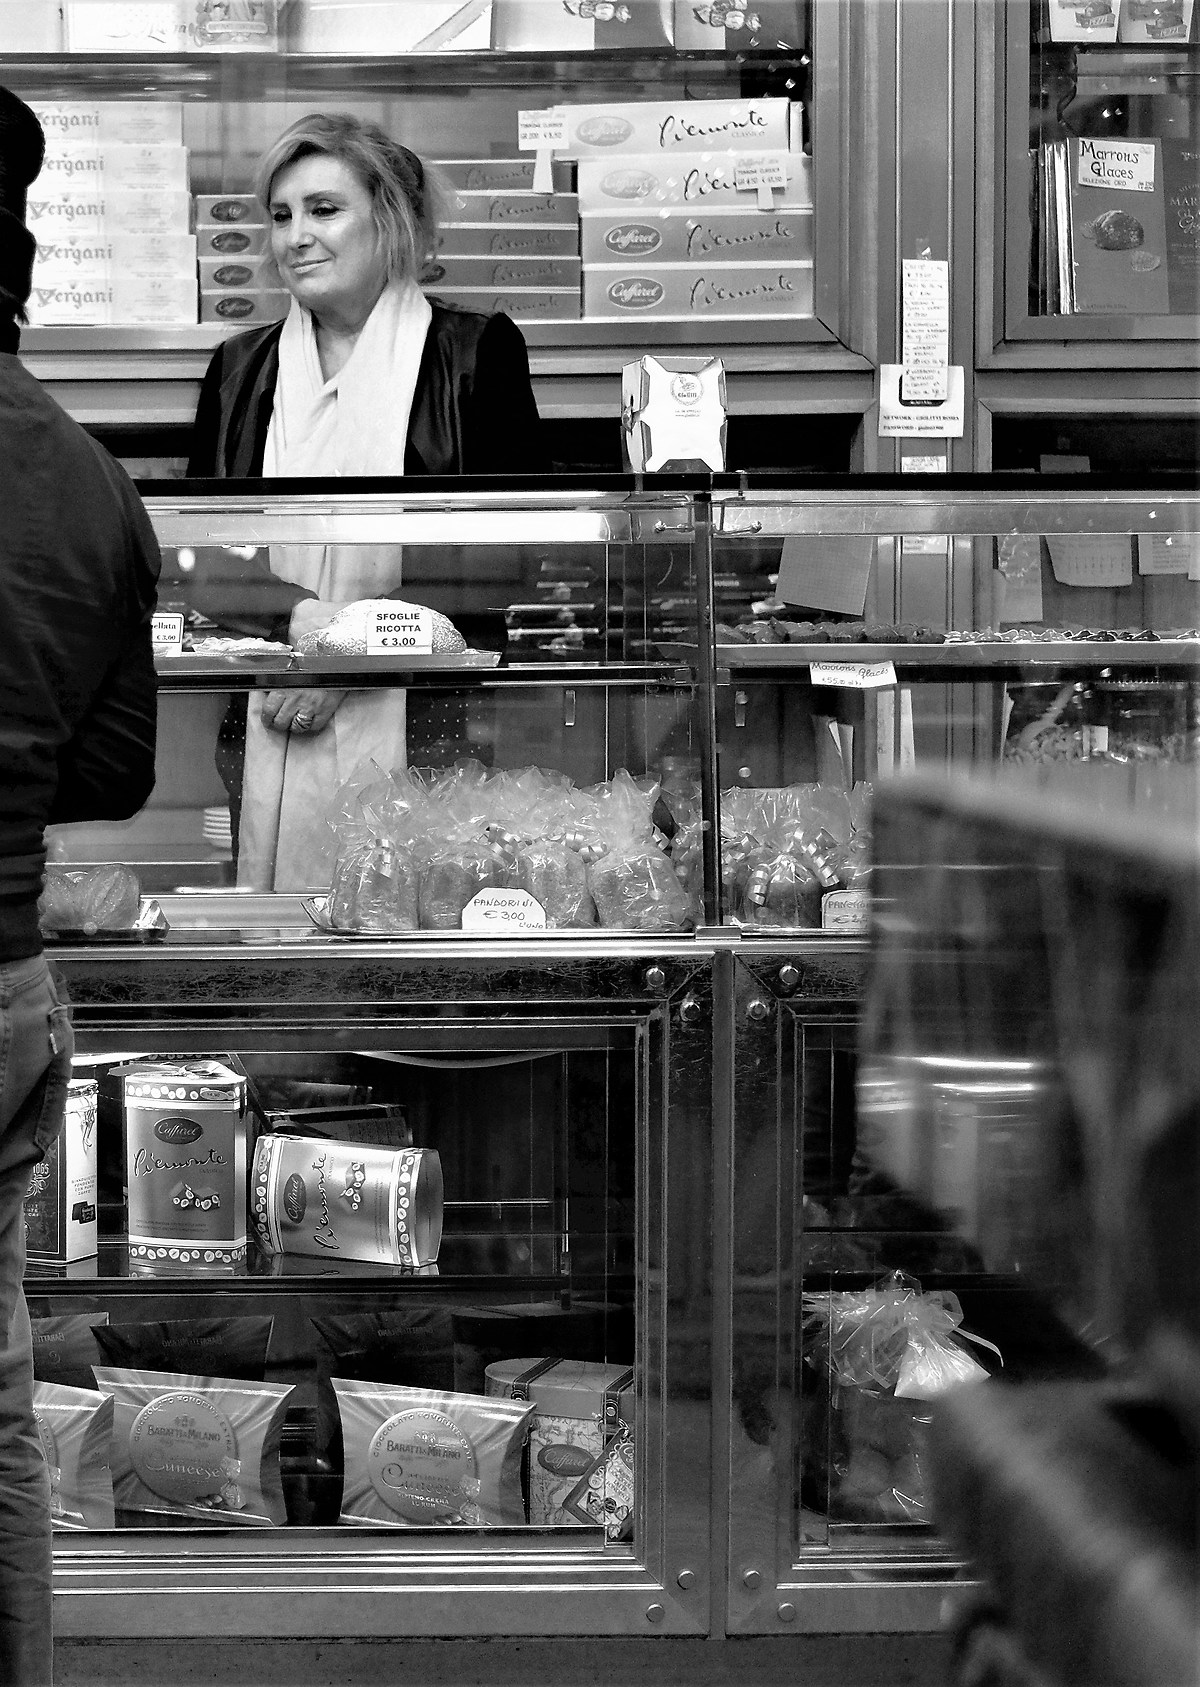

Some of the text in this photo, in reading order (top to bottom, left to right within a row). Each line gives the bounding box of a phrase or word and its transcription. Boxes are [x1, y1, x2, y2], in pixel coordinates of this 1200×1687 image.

[1079, 140, 1139, 164] Marrons
[45, 156, 105, 177] ergani
[1090, 161, 1134, 179] Glaces
[609, 229, 655, 249] Caffarel
[37, 244, 113, 265] Vergani
[32, 288, 113, 309] Vergani
[611, 282, 658, 302] Caffarel
[153, 621, 177, 630] ellata
[376, 612, 421, 621] SFOGLIE
[376, 624, 422, 632] RICOTTA
[473, 897, 534, 908] PANDORINI
[158, 1121, 197, 1140] Caffarel
[134, 1148, 228, 1177] Piemonte
[545, 1448, 590, 1470] Caffarel
